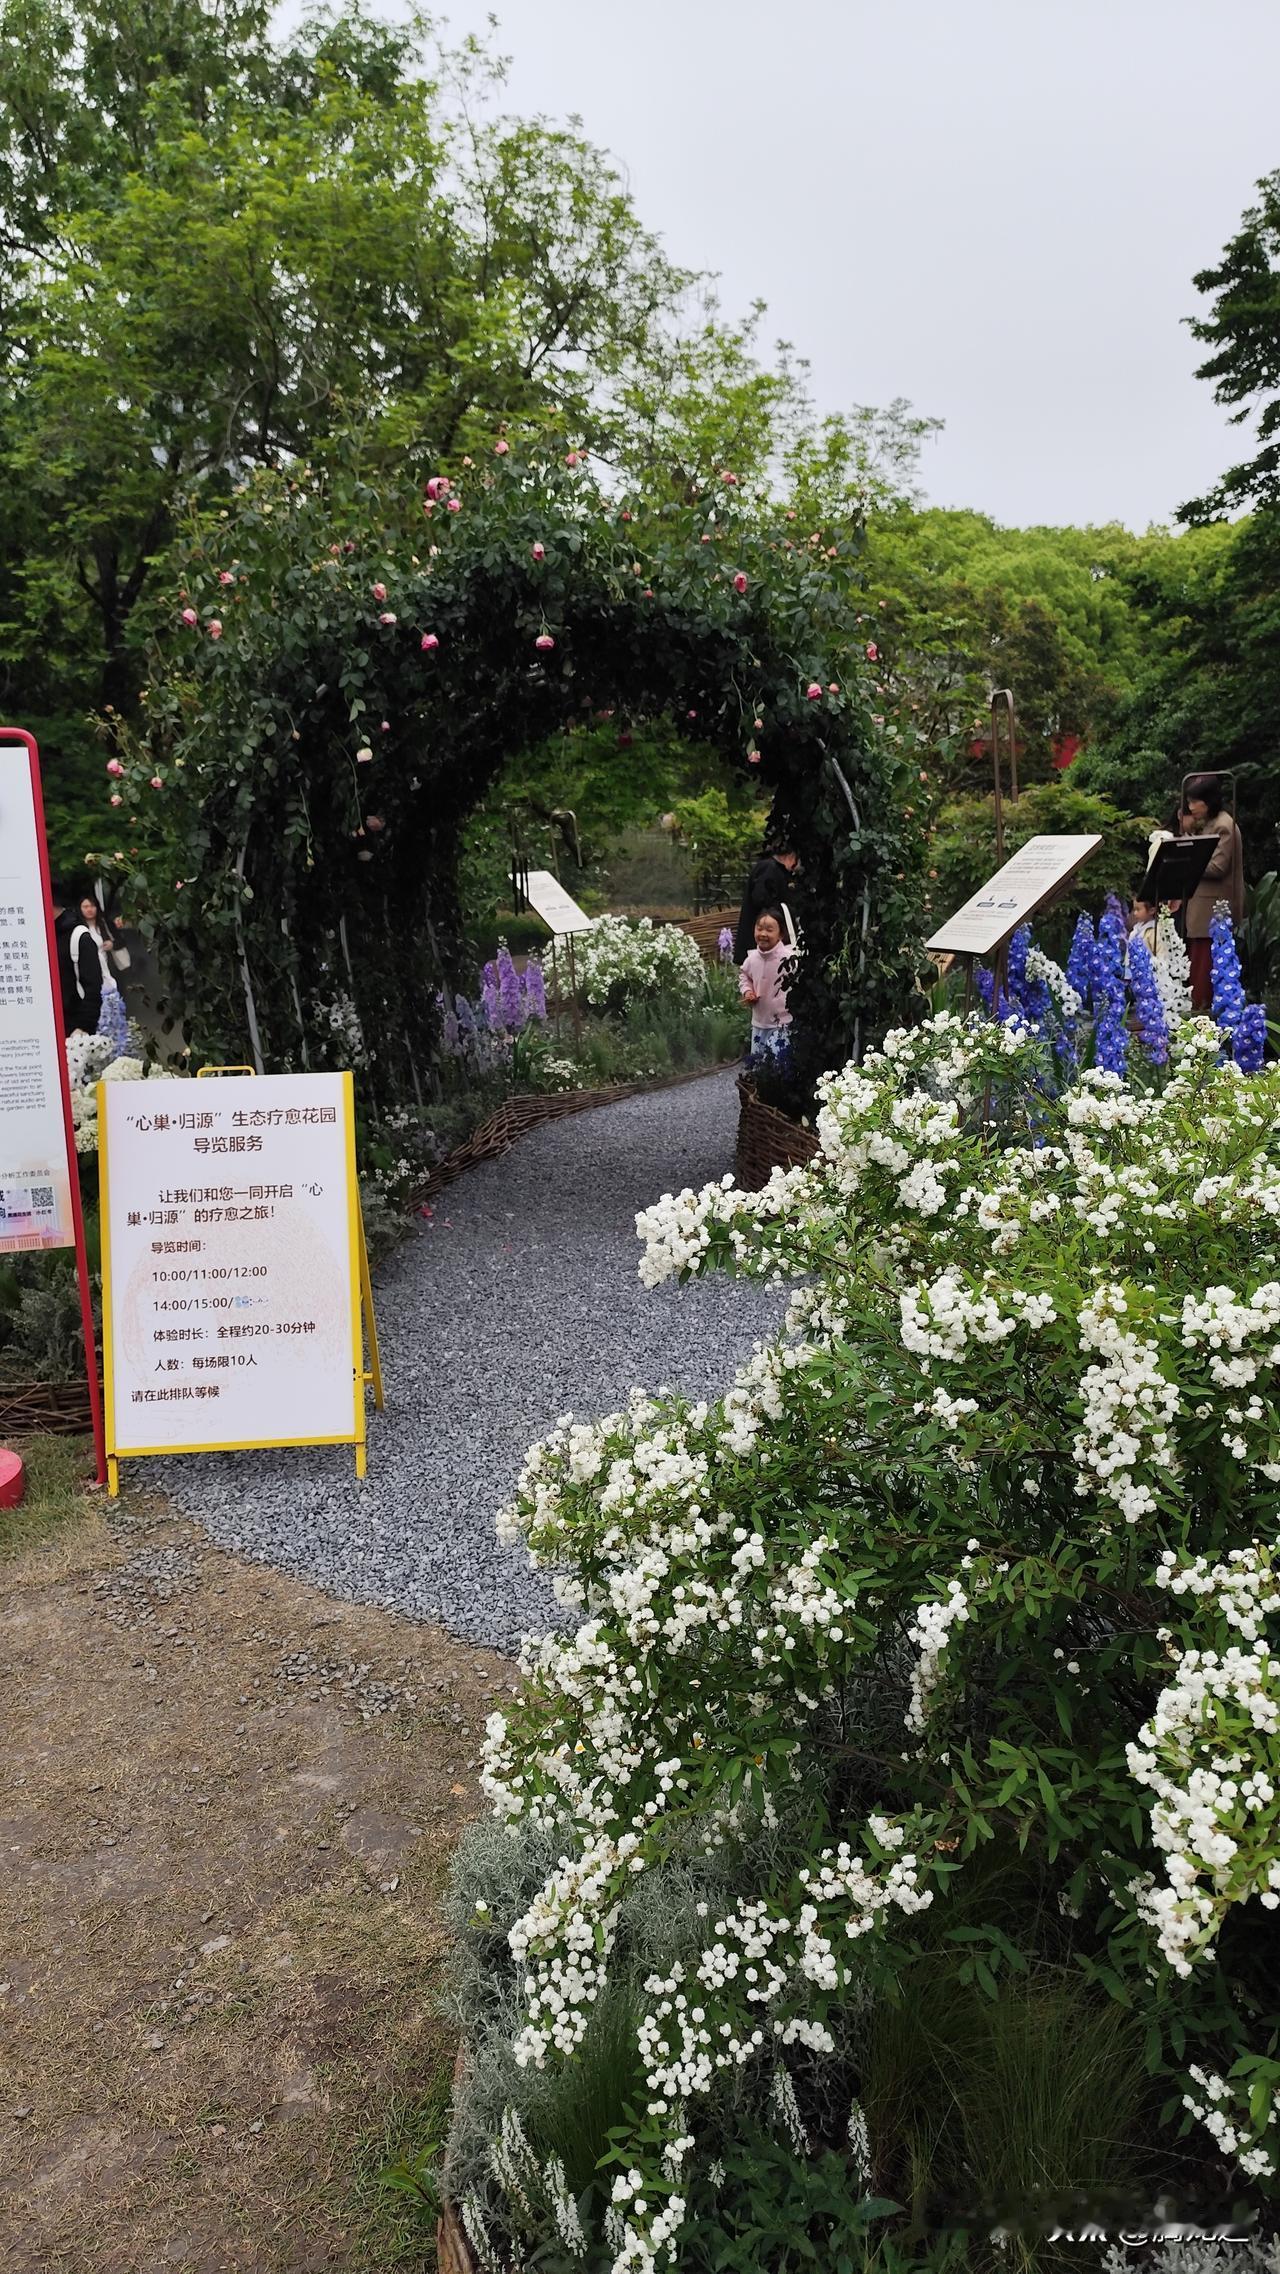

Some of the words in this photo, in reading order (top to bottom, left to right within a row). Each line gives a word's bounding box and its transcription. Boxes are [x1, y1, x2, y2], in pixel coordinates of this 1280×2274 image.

[193, 1135, 263, 1154] 导览服务
[152, 1265, 268, 1282] 10:00/11:00/12:00
[153, 1320, 316, 1342] 体验时长：全程约20-30分钟
[154, 1353, 258, 1372] 人数：每场限10人
[131, 1385, 220, 1403] 请在此排队等候
